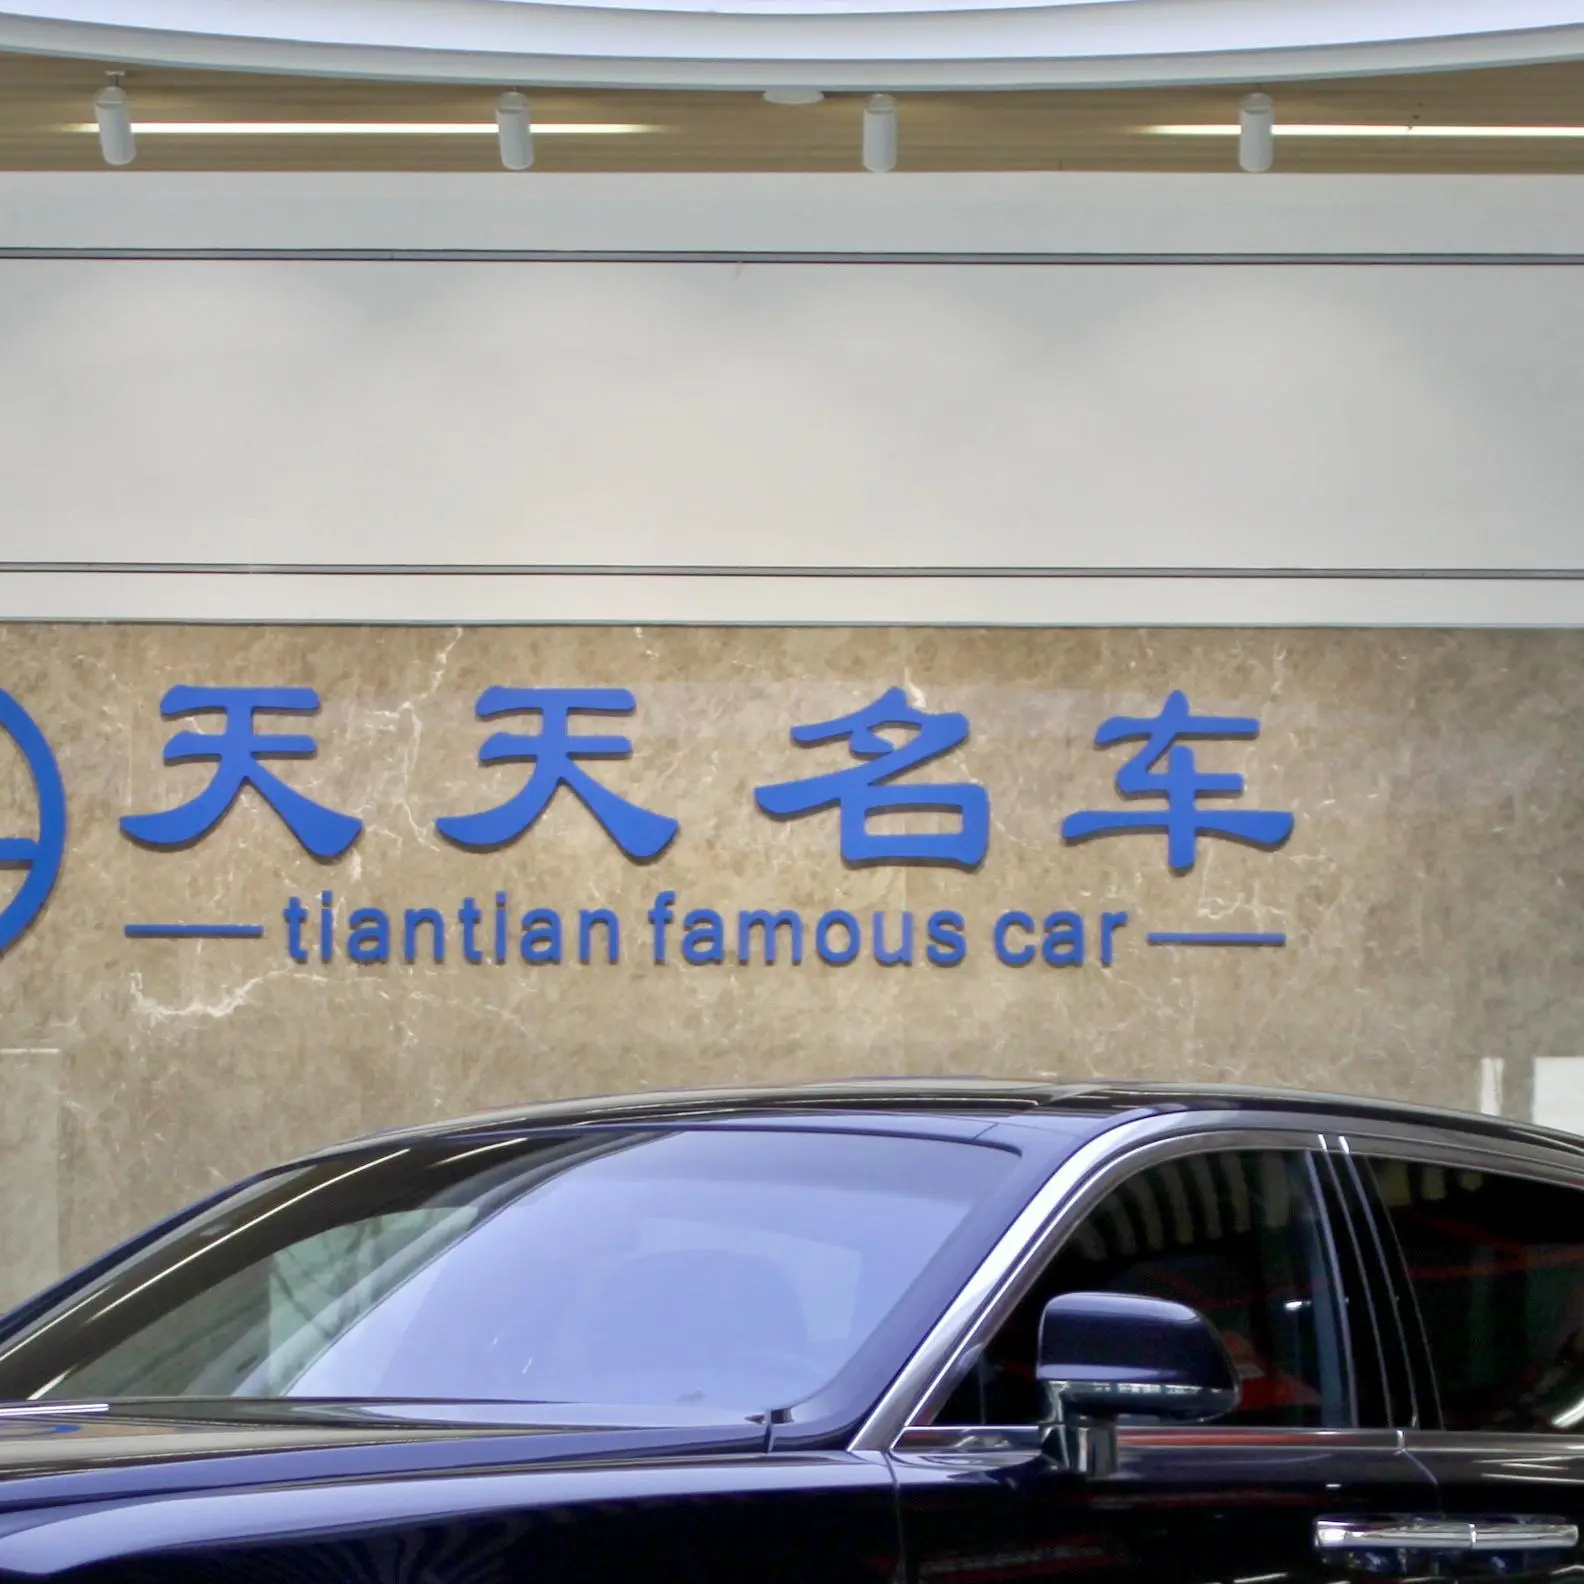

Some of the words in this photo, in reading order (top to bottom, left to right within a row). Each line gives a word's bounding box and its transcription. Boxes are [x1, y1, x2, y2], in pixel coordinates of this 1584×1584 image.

[118, 684, 1295, 869] 天天名车
[282, 891, 620, 961] tiantian
[648, 891, 966, 963] famous
[994, 911, 1129, 964] car
